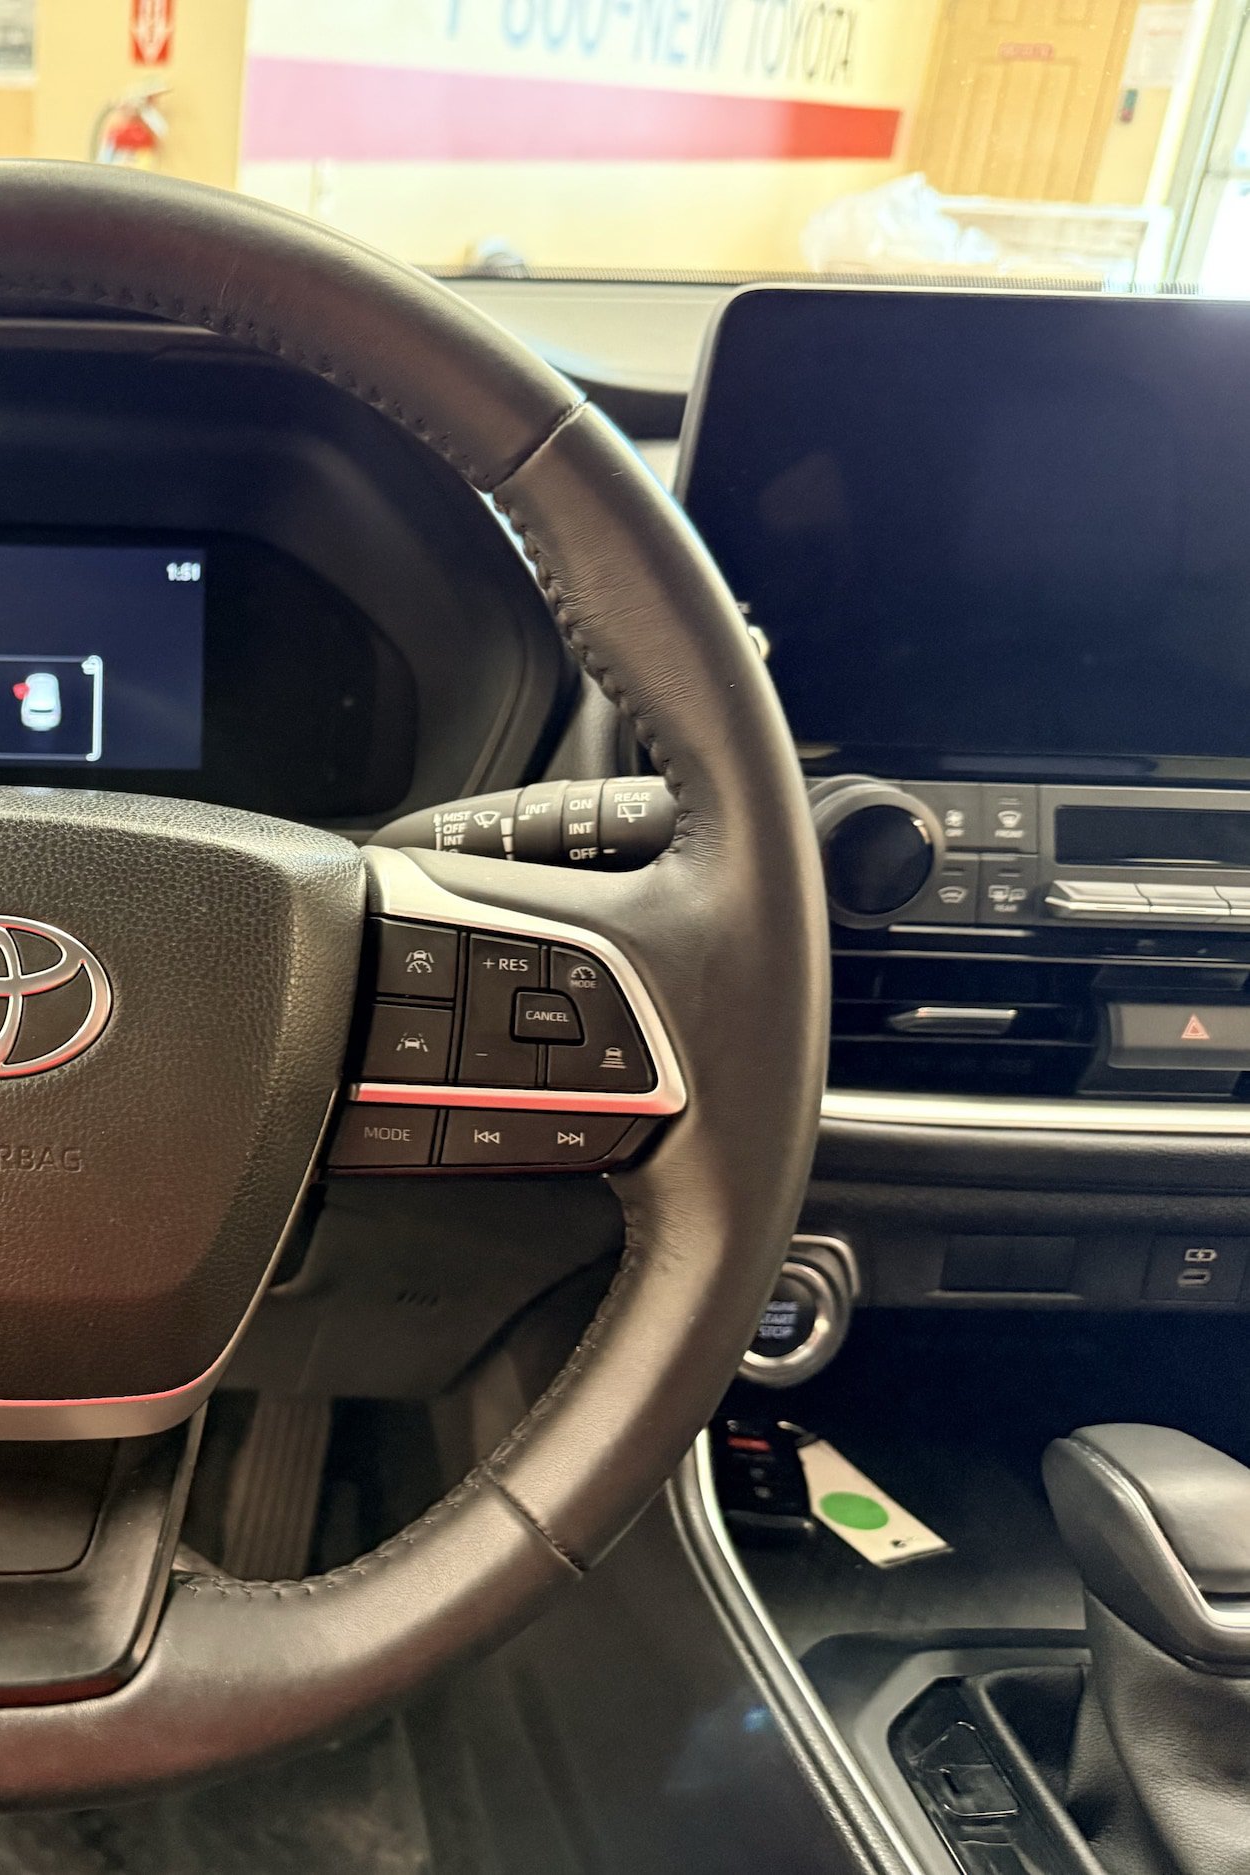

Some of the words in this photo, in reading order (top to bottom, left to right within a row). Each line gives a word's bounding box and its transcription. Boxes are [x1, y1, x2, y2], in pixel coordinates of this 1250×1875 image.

[614, 792, 651, 803] REAR
[525, 802, 551, 814] INT
[569, 799, 593, 810] ON
[443, 810, 472, 823] MIST
[443, 823, 467, 834] OFF
[569, 821, 595, 835] INT
[443, 834, 465, 846] INT
[569, 847, 598, 860] OFF
[571, 979, 597, 989] MODE
[526, 1010, 569, 1023] CANCEL
[364, 1127, 412, 1142] MODE
